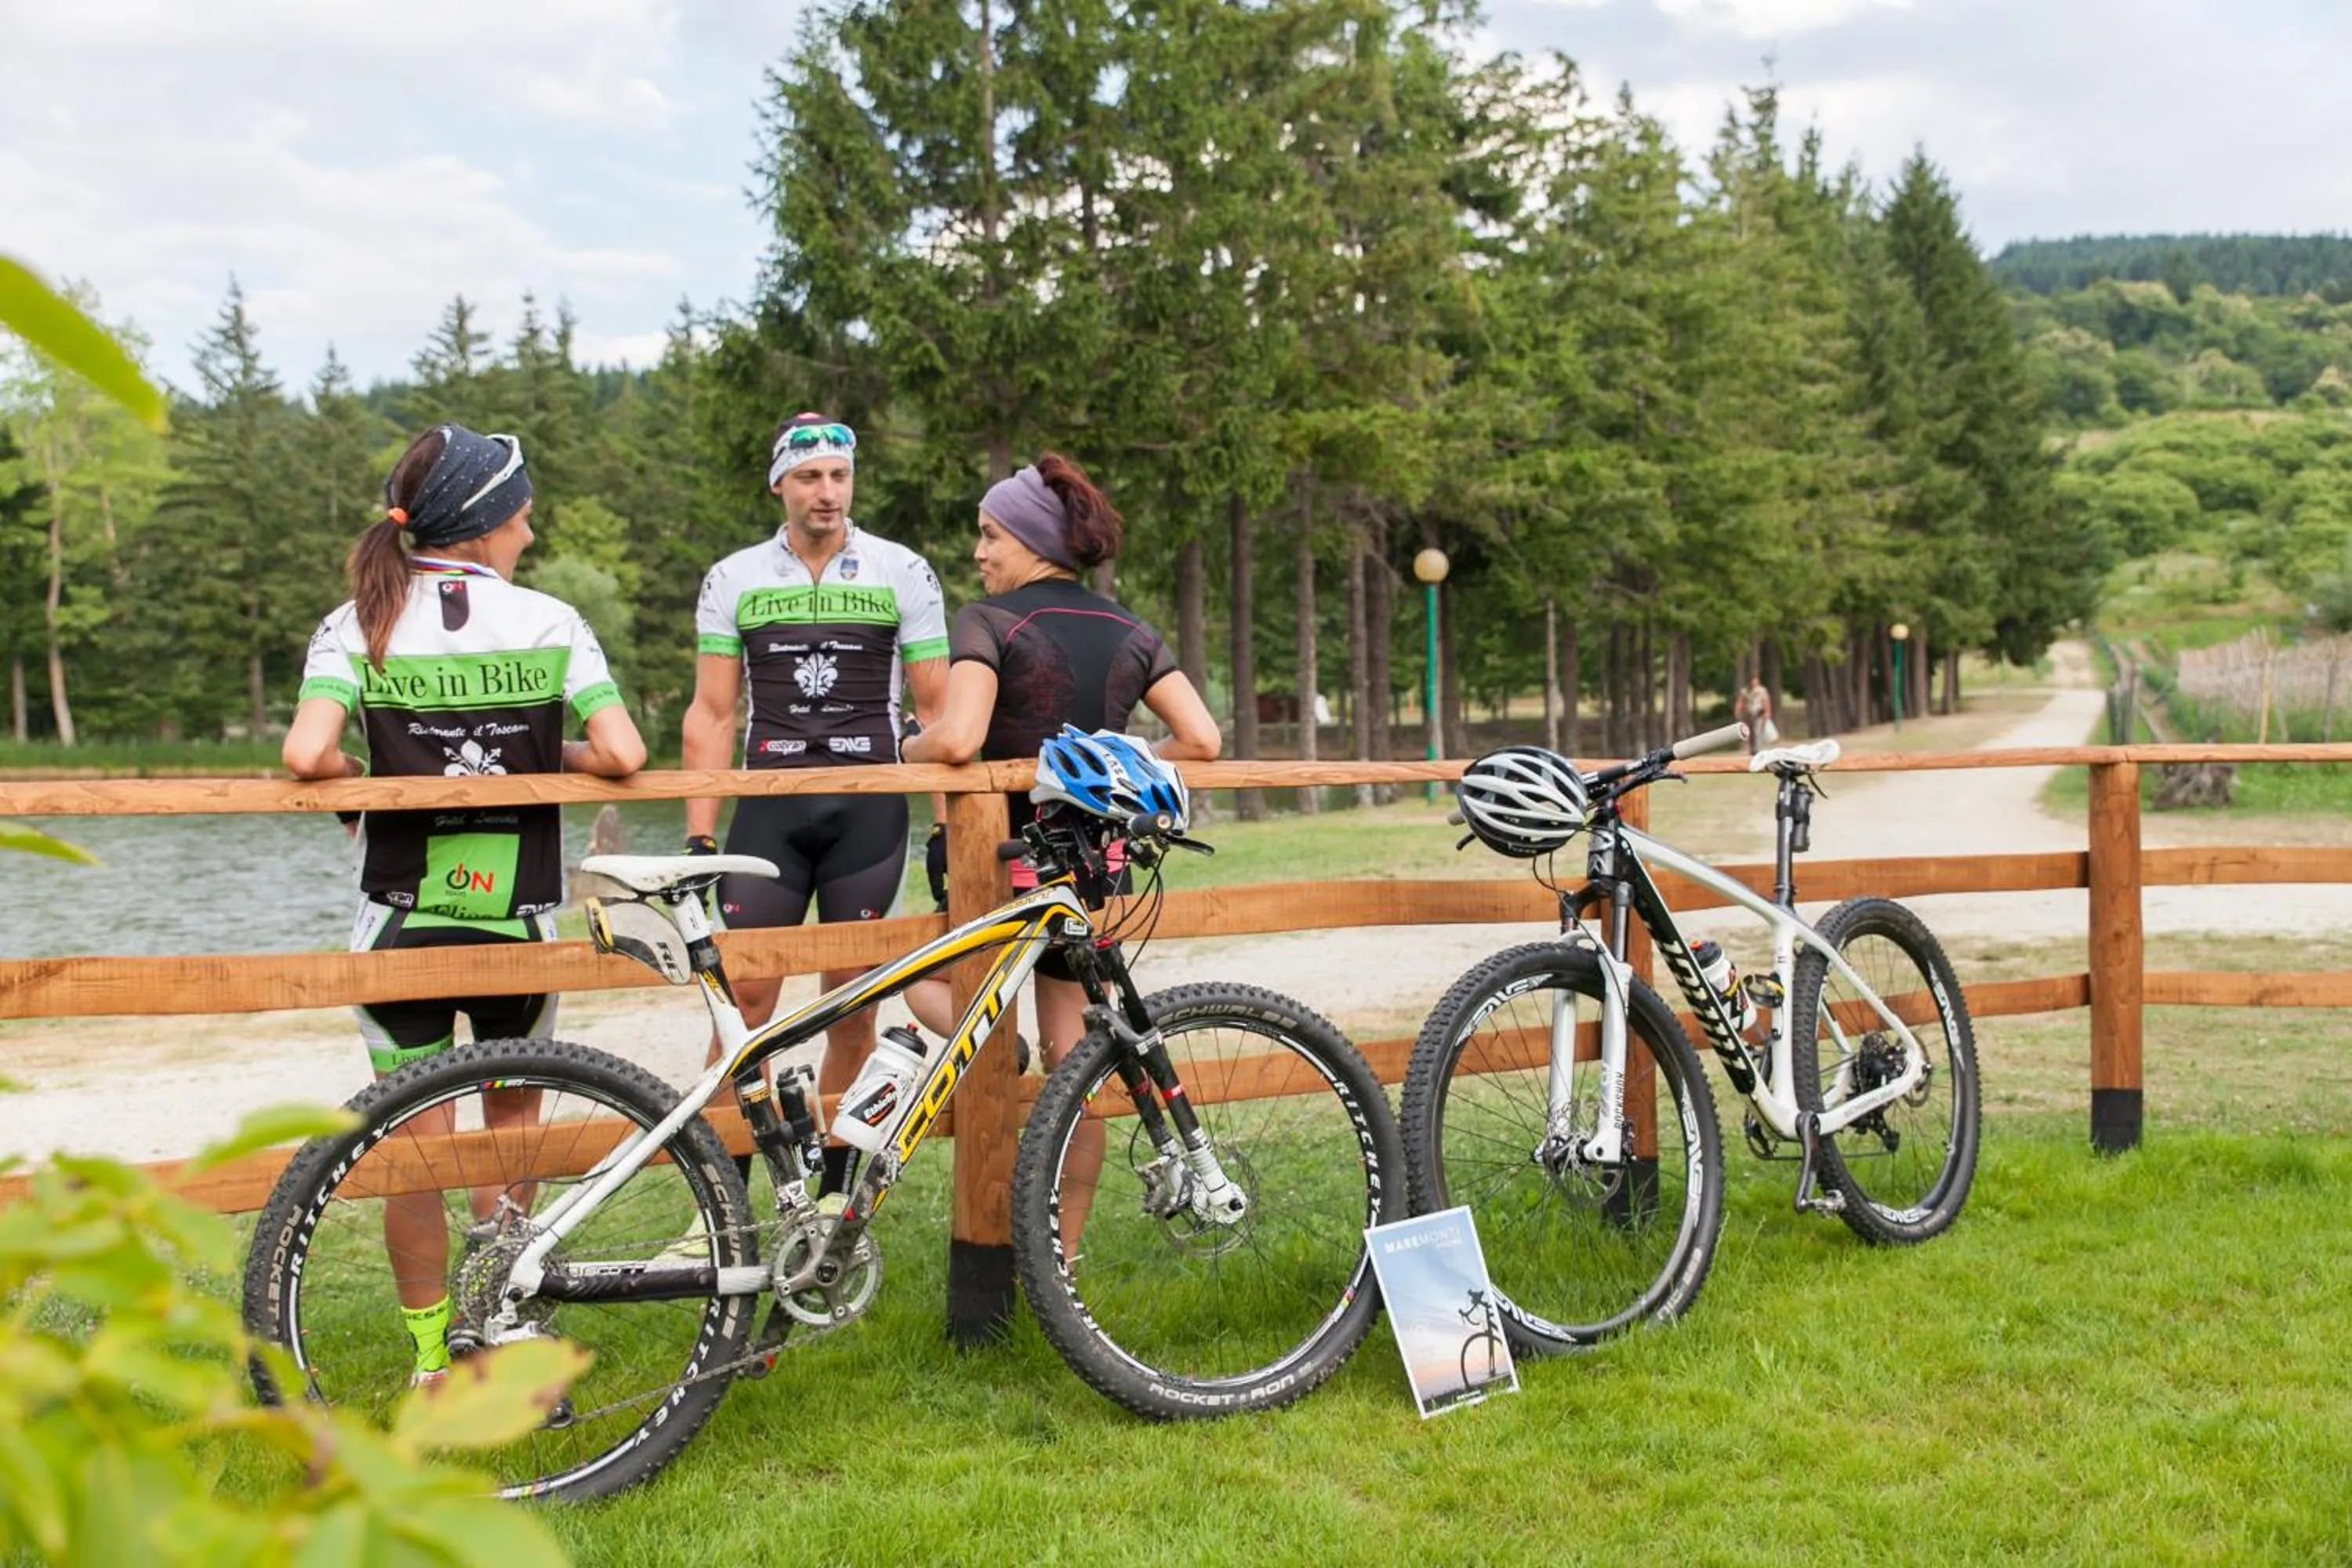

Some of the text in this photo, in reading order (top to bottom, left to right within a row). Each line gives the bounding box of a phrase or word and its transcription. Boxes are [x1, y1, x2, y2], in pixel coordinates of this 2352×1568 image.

[752, 592, 892, 616] Live in Bike
[437, 666, 468, 697] in
[478, 661, 548, 695] Bike
[446, 862, 494, 893] ON
[897, 970, 1006, 1164] COTT
[290, 1121, 388, 1277] RITCHEY
[1334, 1081, 1381, 1214] RITCHEY
[701, 1163, 743, 1341] SCHWABE
[1050, 1189, 1099, 1330] RITCHEY
[636, 1296, 720, 1447] RITCHEY
[1149, 1373, 1295, 1406] ROCKET RON
